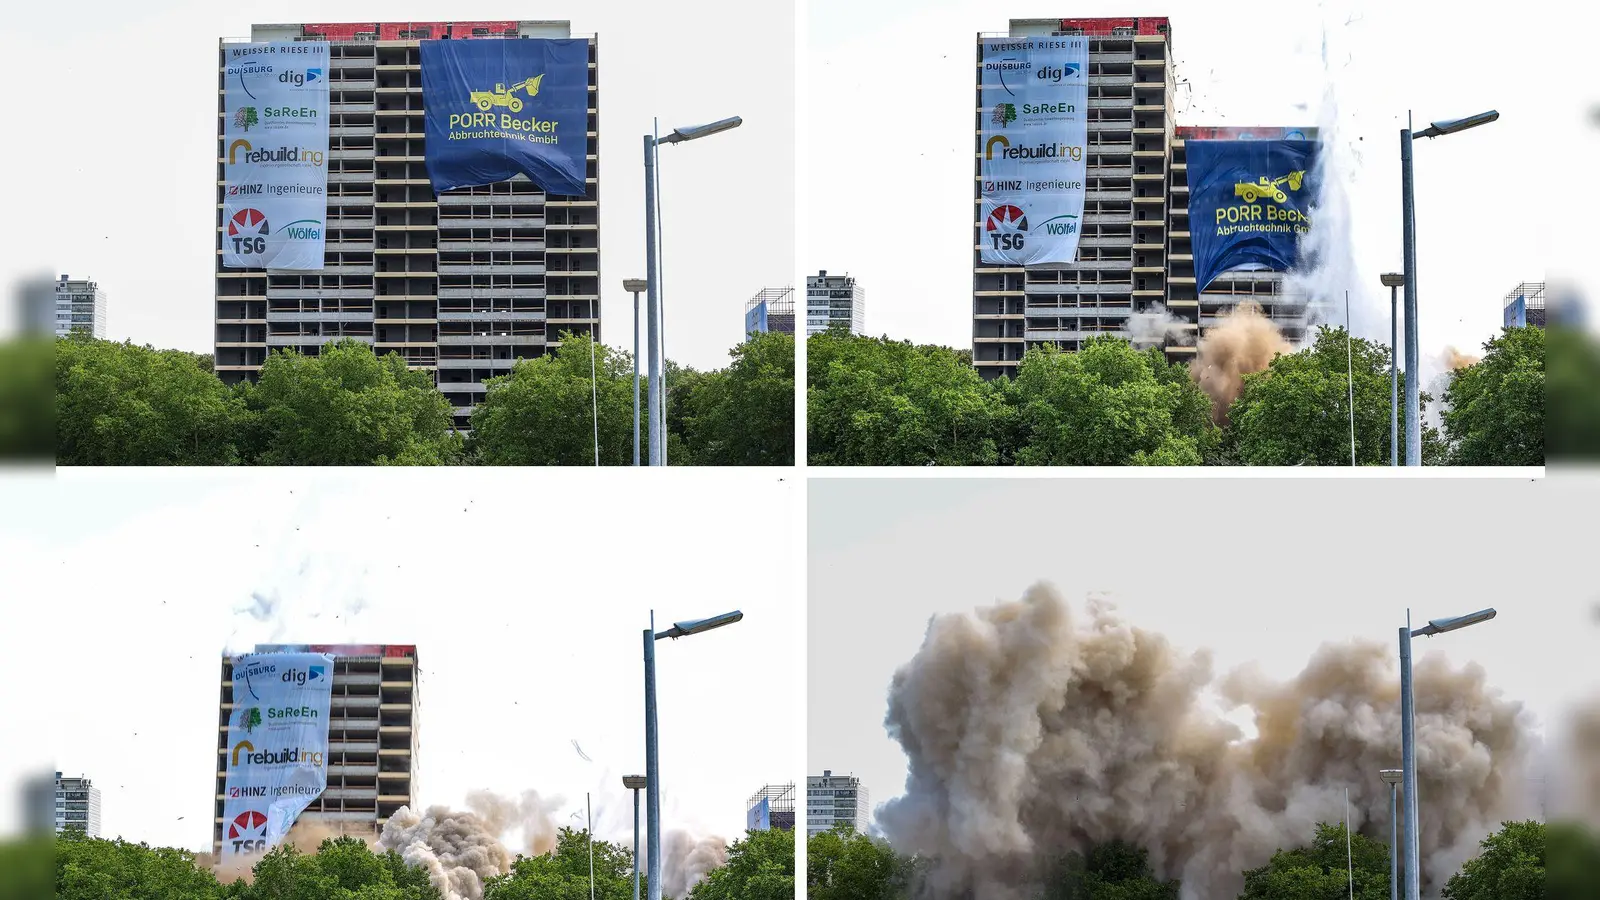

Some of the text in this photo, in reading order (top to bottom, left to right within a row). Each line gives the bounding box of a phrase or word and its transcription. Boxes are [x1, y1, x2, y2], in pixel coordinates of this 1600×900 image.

[233, 47, 276, 56] WEISSER
[991, 42, 1034, 51] WEISSER
[278, 70, 304, 87] dig
[1037, 66, 1061, 82] dig
[264, 107, 317, 117] SaReEn
[1023, 103, 1075, 114] SaReEn
[449, 113, 558, 132] PORR Becker
[448, 130, 558, 144] Abbruchtechnik GmbH
[246, 147, 323, 166] rebuild.ing
[1003, 143, 1081, 161] rebuild.ing
[240, 183, 322, 195] HINZ Ingenieure
[997, 179, 1081, 191] HINZ Ingenieure
[1216, 205, 1309, 224] PORR Beck
[288, 227, 320, 239] Wölfel
[1047, 222, 1076, 235] Wölfel
[1293, 224, 1309, 233] Gm
[232, 237, 266, 254] TSG
[991, 233, 1024, 250] TSG
[282, 668, 306, 686] dig
[268, 706, 318, 718] SaReEn
[247, 747, 322, 767] rebuild.ing
[242, 786, 266, 796] HINZ
[232, 840, 266, 855] TSG
